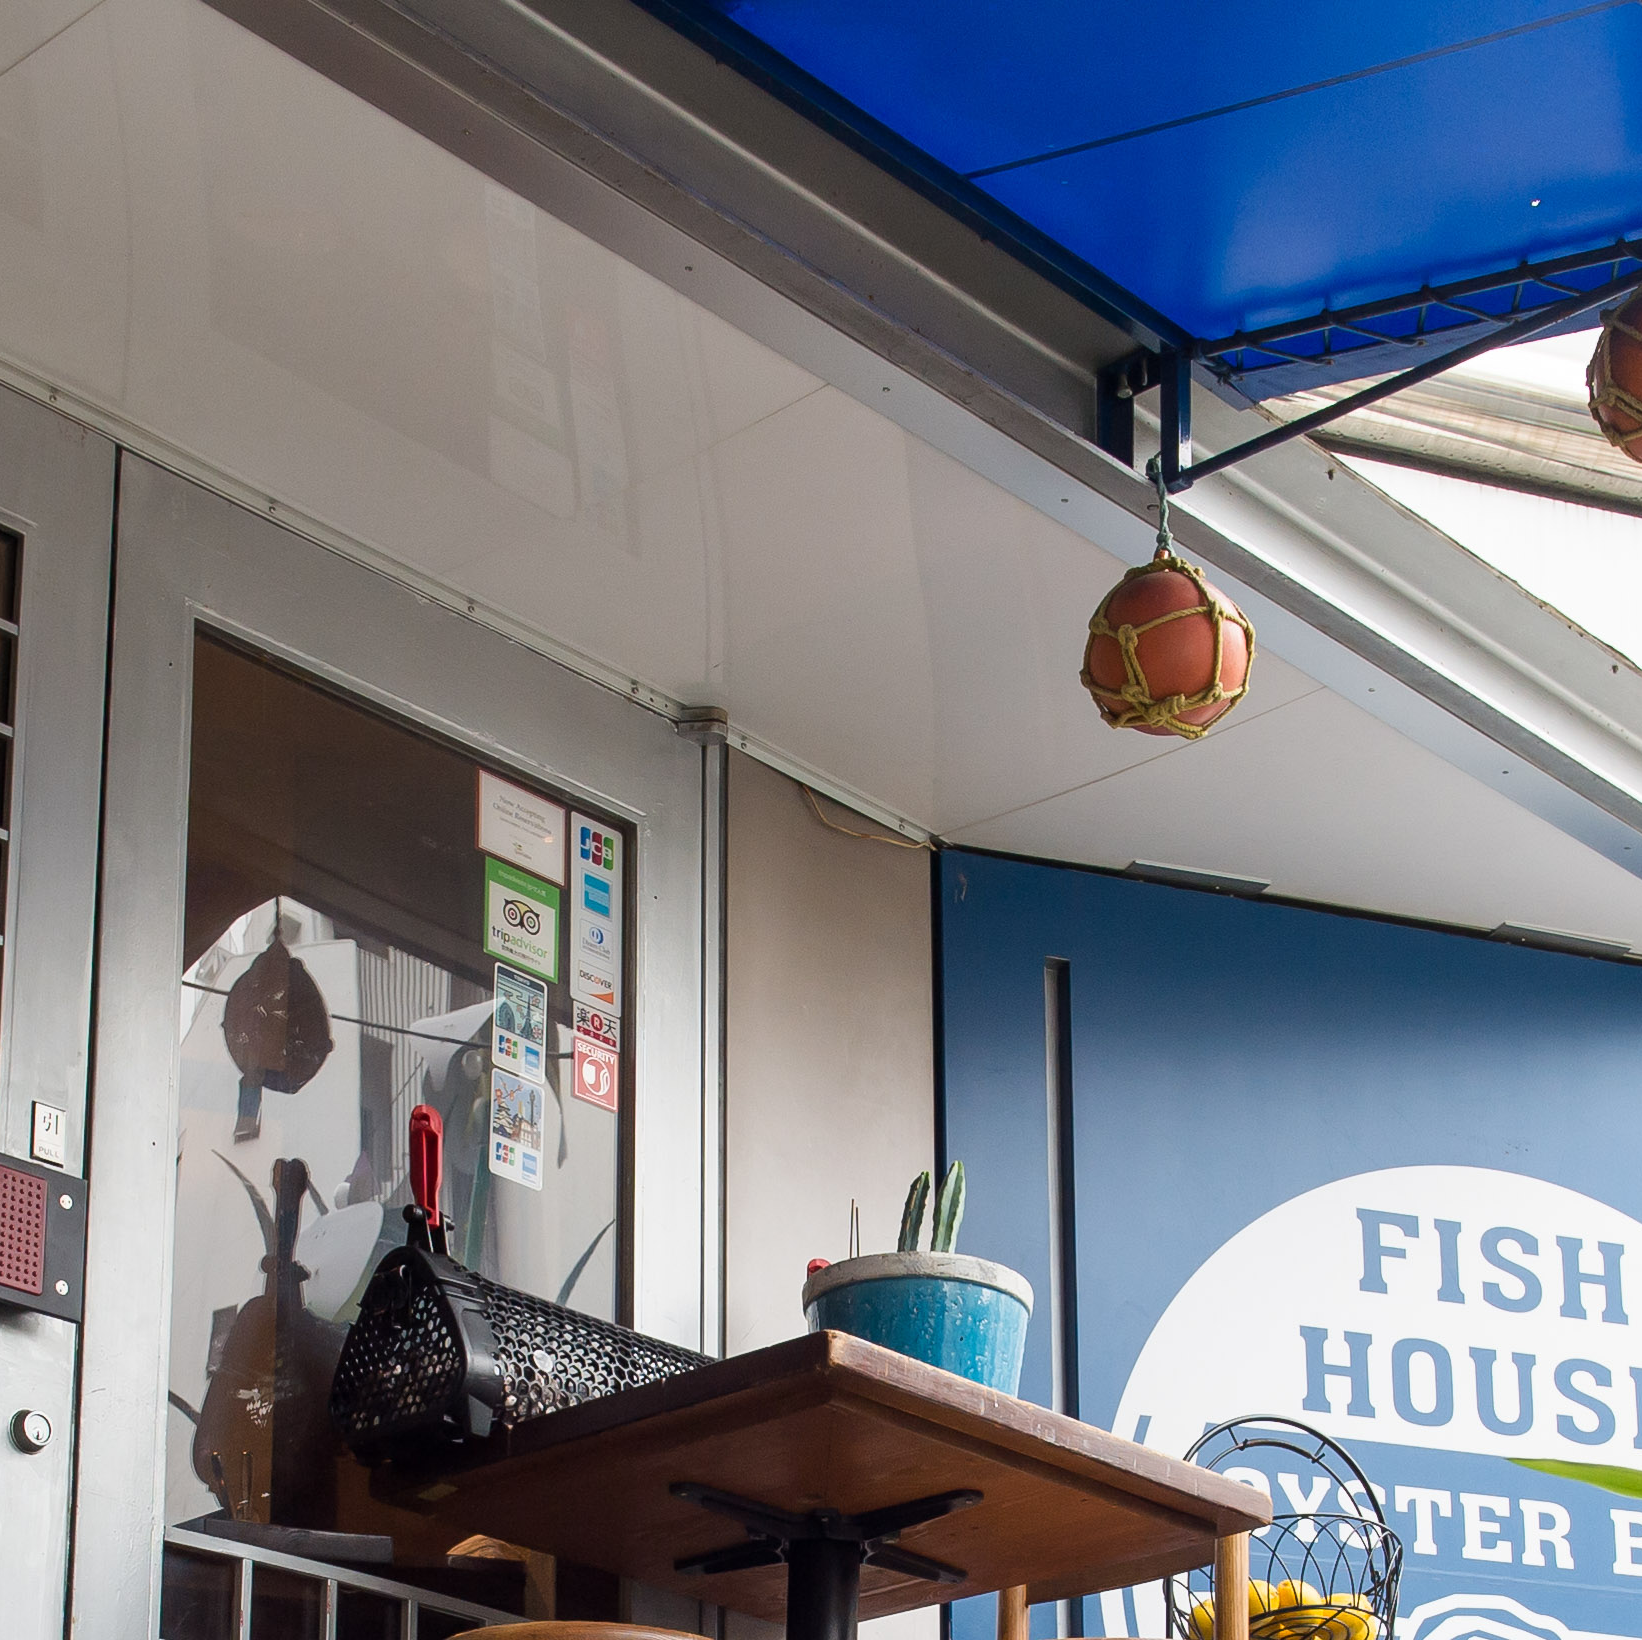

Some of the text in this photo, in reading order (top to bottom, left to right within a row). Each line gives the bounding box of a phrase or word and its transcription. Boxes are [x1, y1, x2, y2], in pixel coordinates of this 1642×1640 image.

[580, 832, 614, 866] JCB
[491, 925, 548, 959] tripadvisor
[579, 969, 612, 990] DISCOVER
[577, 1041, 615, 1065] SECURITY
[42, 1112, 59, 1136] 引
[38, 1146, 60, 1159] PULL
[1356, 1207, 1629, 1326] FISH
